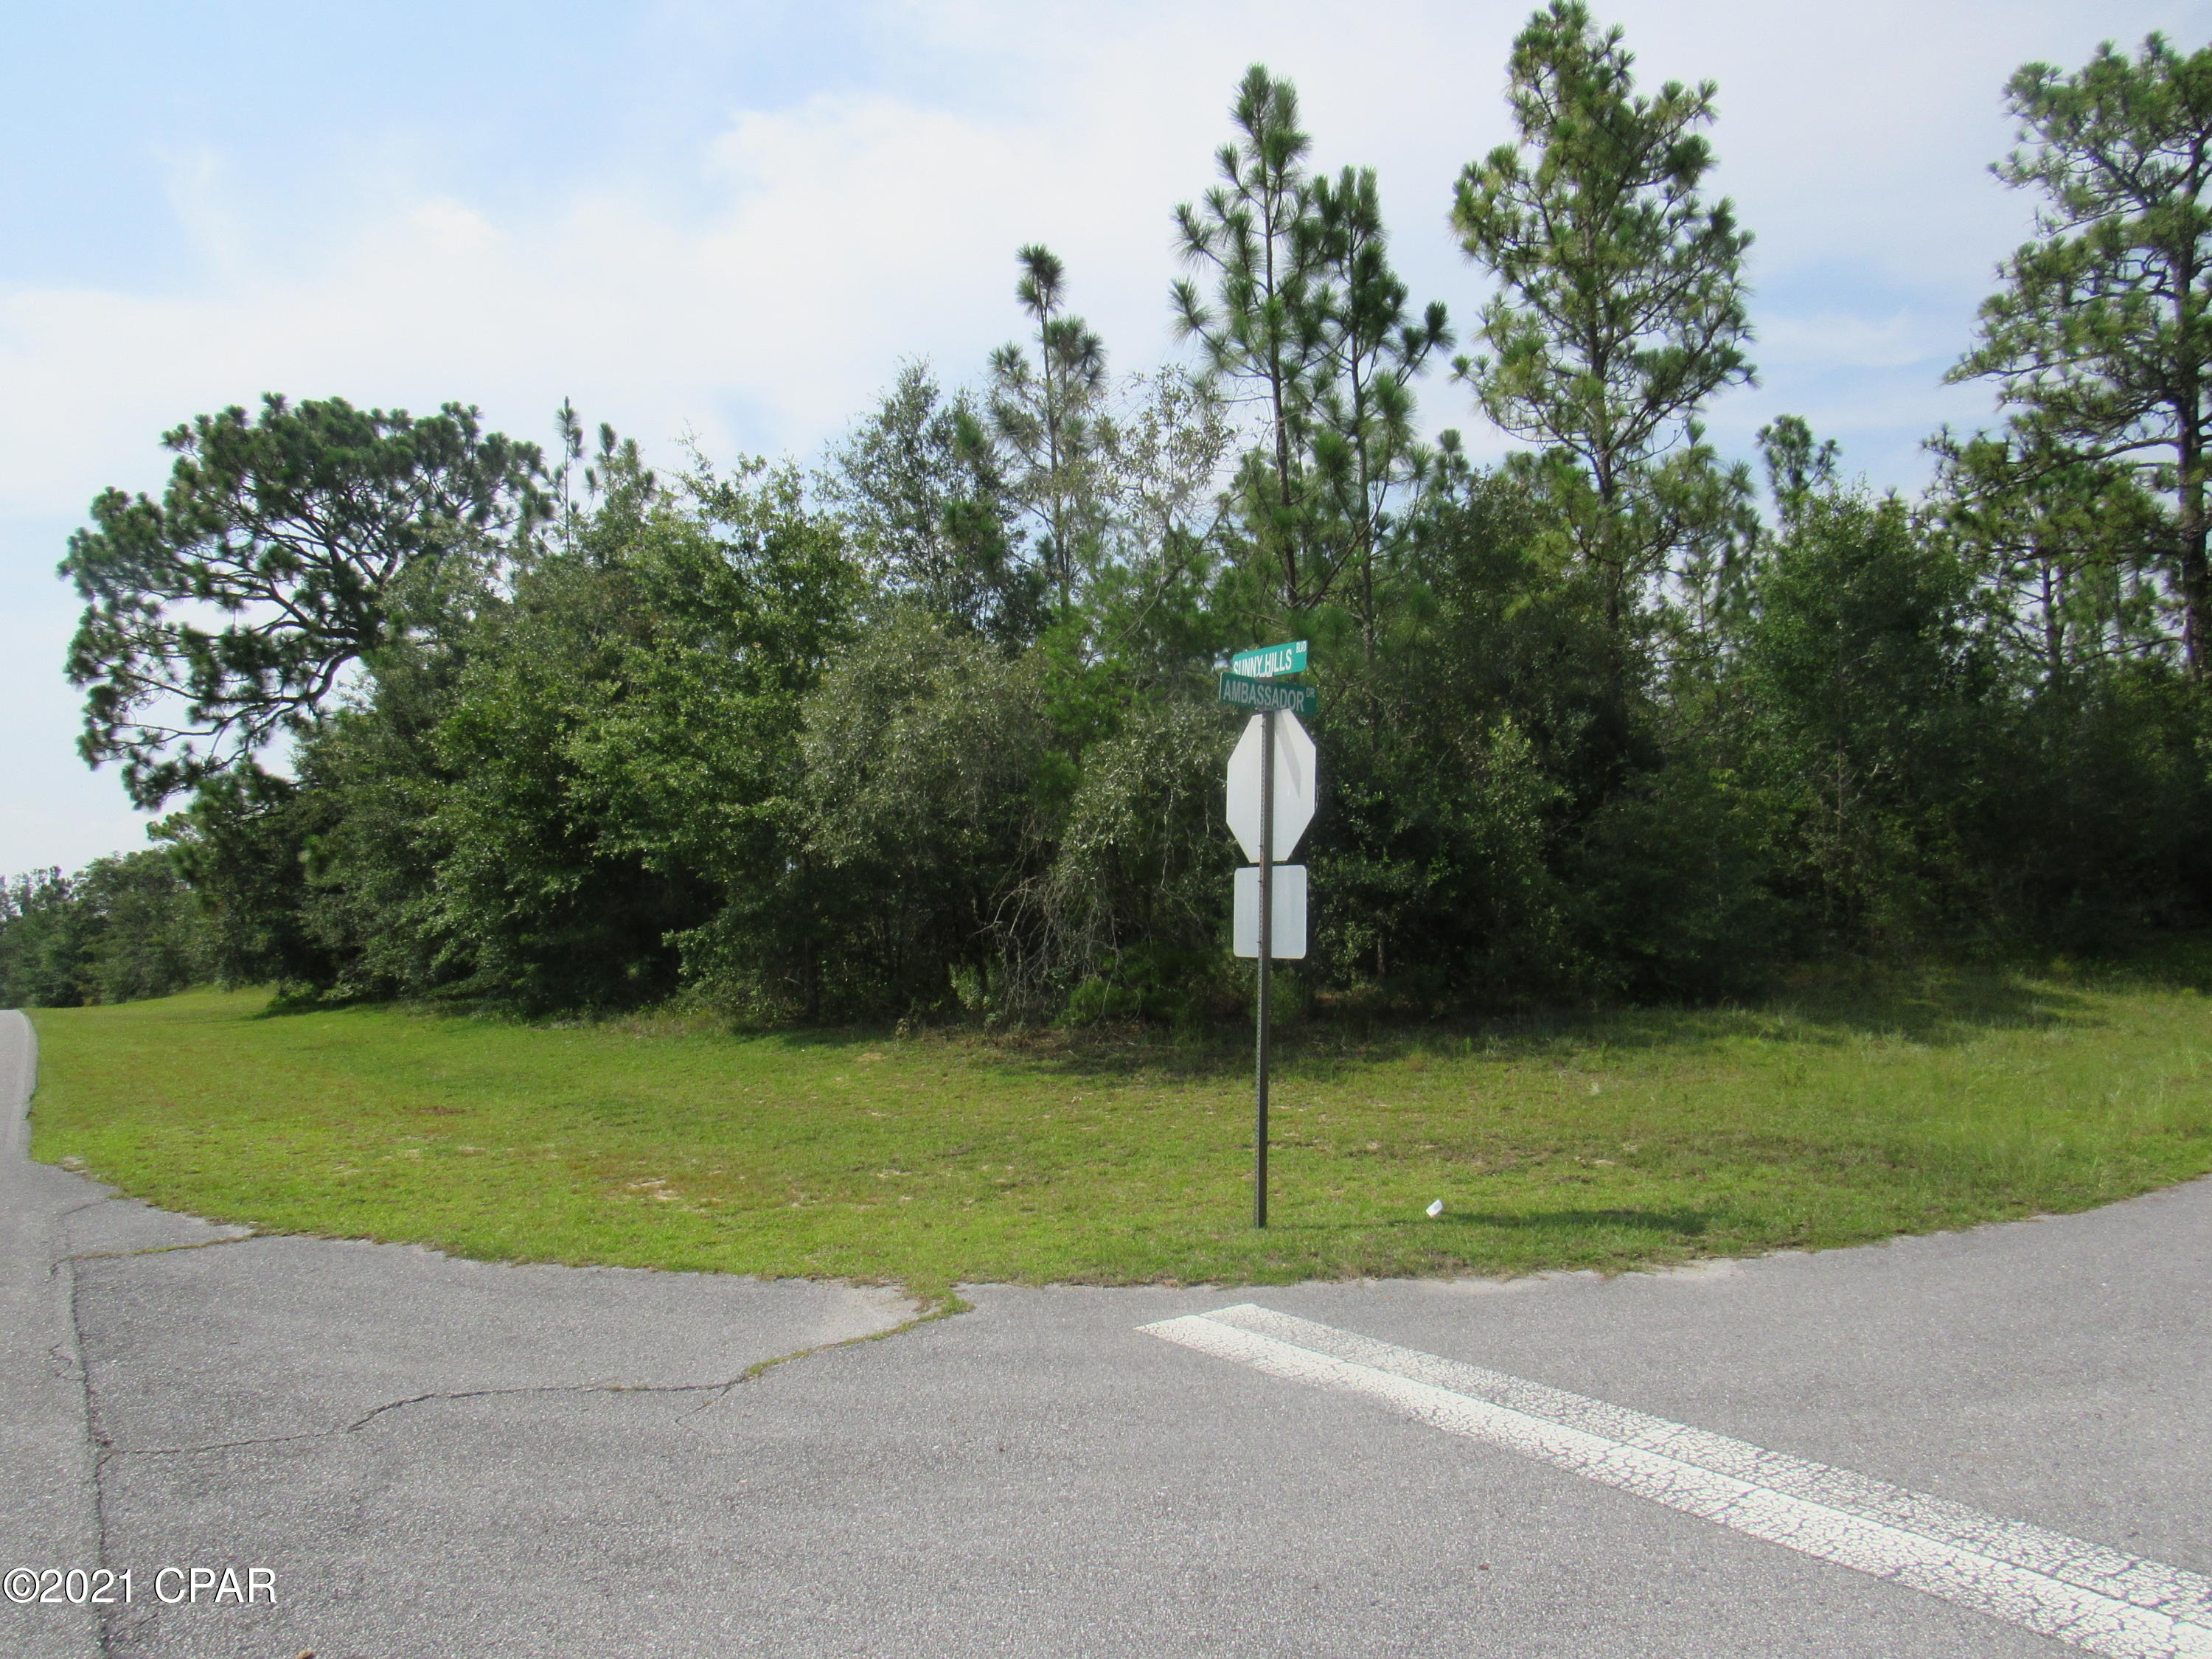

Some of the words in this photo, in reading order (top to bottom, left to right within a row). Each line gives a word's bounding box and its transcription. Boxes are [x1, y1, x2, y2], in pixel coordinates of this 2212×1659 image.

[1234, 655, 1263, 678] SUNNY
[1265, 649, 1292, 675] HILLS
[1295, 641, 1307, 653] BLVD
[1222, 679, 1304, 712] AMBASSADOR
[1306, 687, 1315, 698] DR
